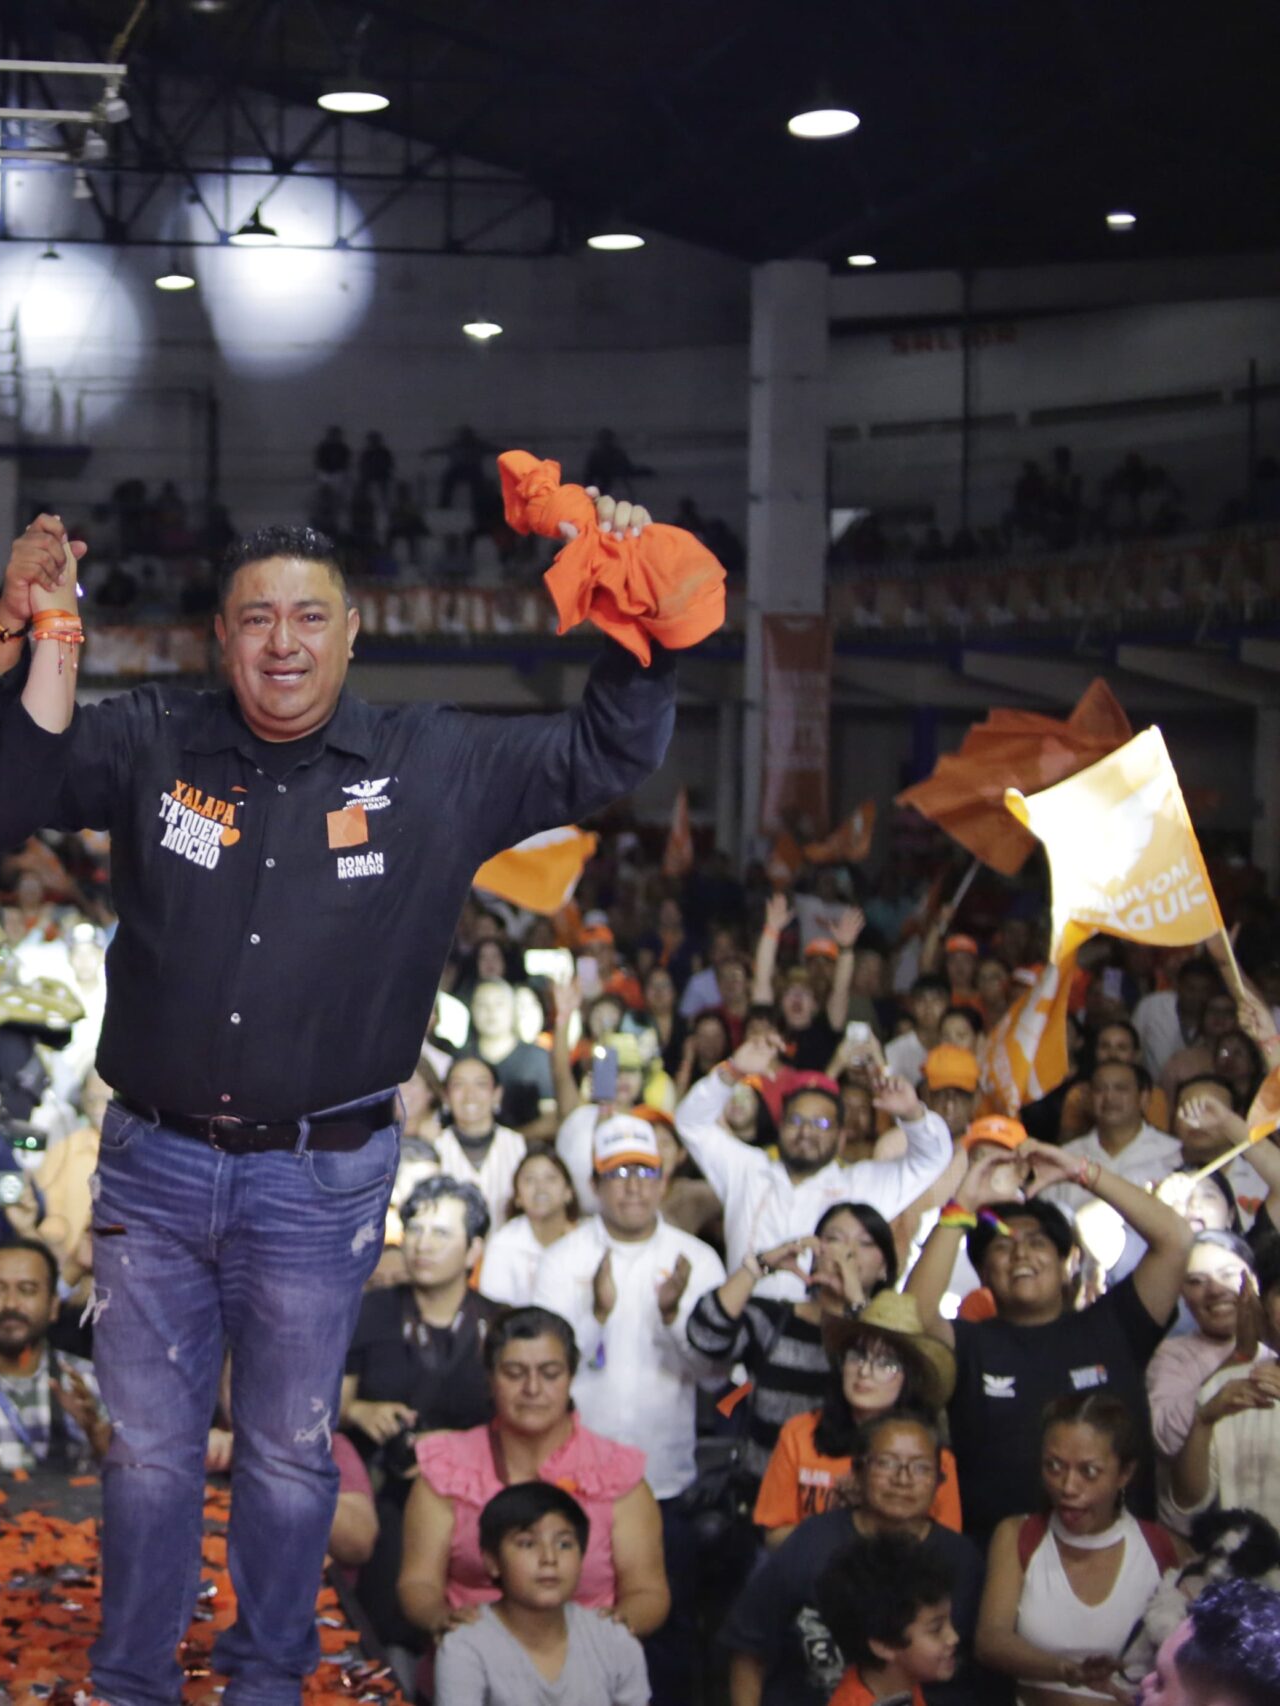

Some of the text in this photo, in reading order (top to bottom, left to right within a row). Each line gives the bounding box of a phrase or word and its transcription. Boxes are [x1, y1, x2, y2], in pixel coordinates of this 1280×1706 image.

[171, 779, 236, 826] XALAPA
[337, 851, 384, 869] ROMÁN
[337, 864, 385, 879] MORENO
